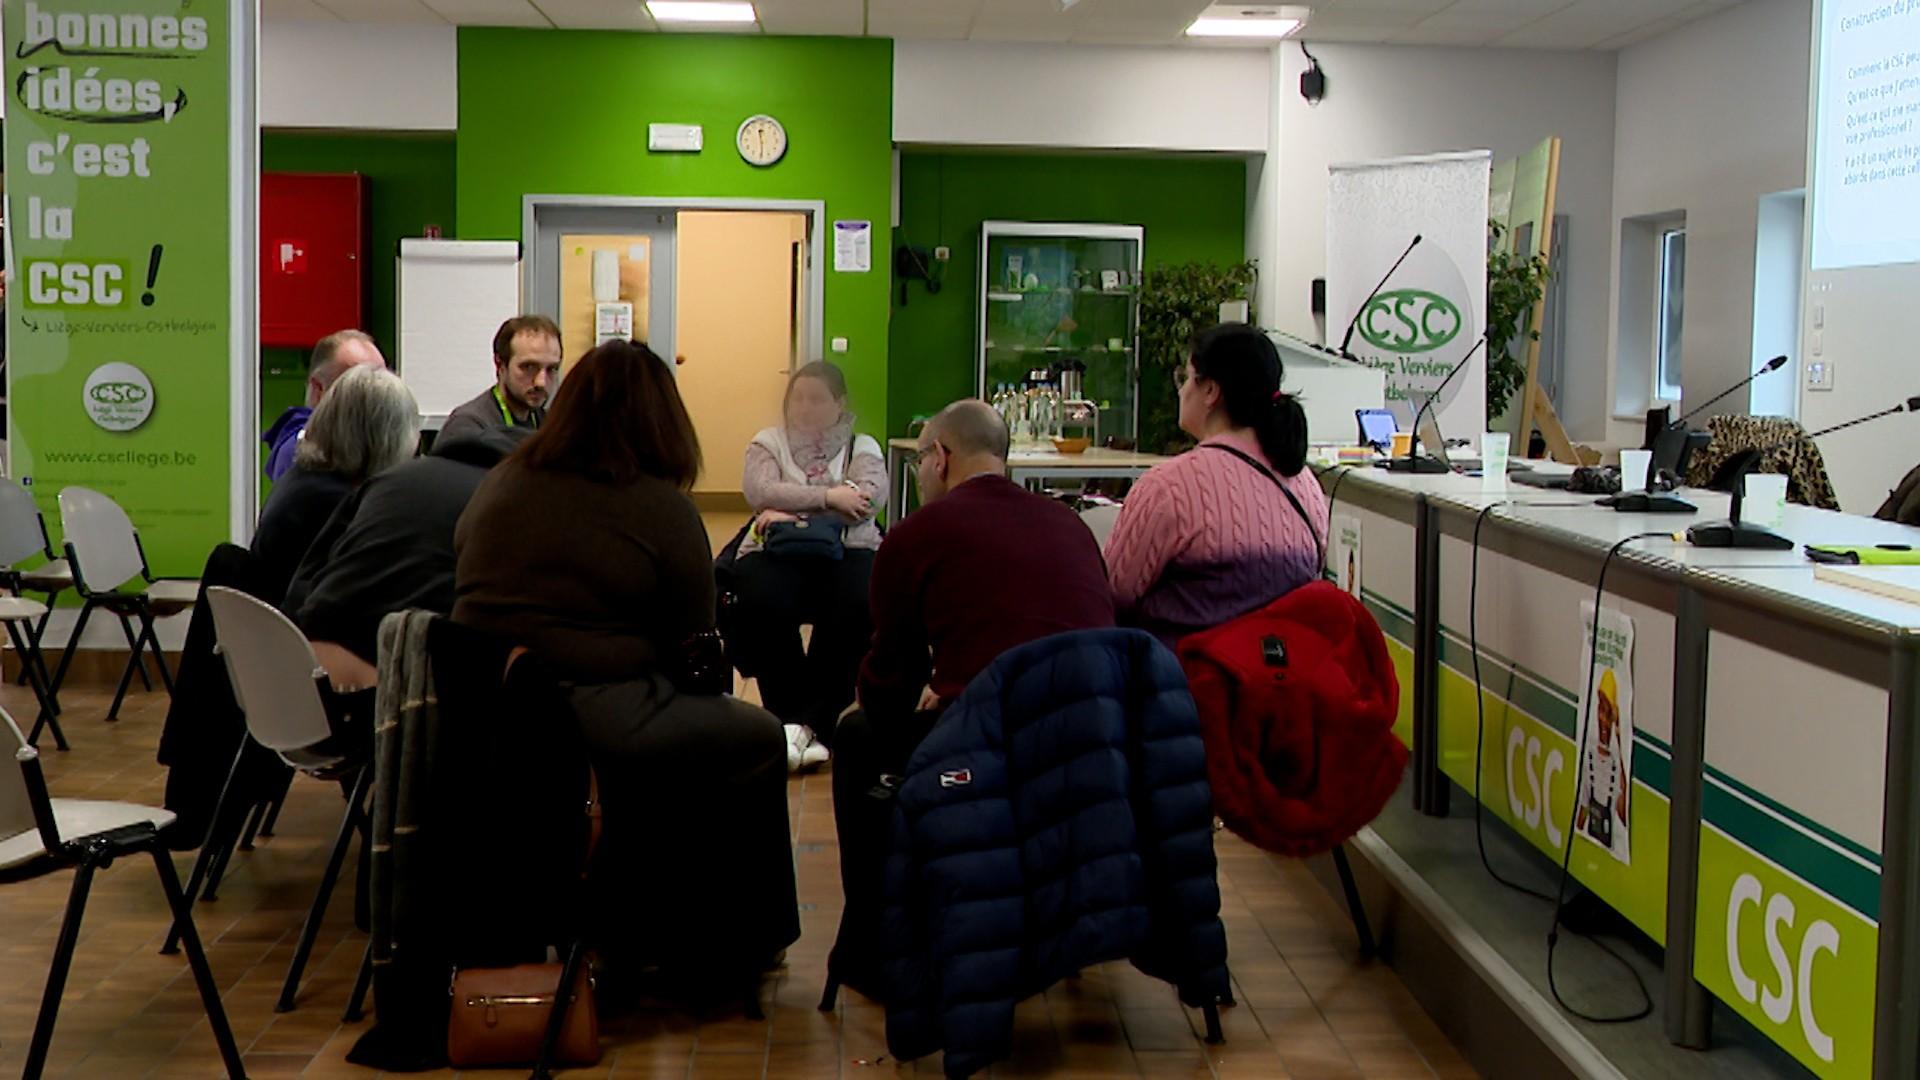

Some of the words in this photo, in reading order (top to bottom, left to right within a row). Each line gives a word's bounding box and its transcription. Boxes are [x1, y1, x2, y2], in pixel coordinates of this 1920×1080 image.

[26, 3, 208, 50] bonnes
[27, 67, 177, 123] idées,
[27, 134, 150, 177] c'est
[28, 197, 73, 240] la
[29, 262, 123, 305] CSC
[141, 243, 163, 307] !
[1367, 296, 1447, 349] CSC
[1398, 356, 1453, 377] Verviers
[96, 384, 140, 403] CSC
[45, 450, 197, 467] www.cscliege.be
[1507, 726, 1564, 848] CSC
[1727, 873, 1840, 1062] CSC
